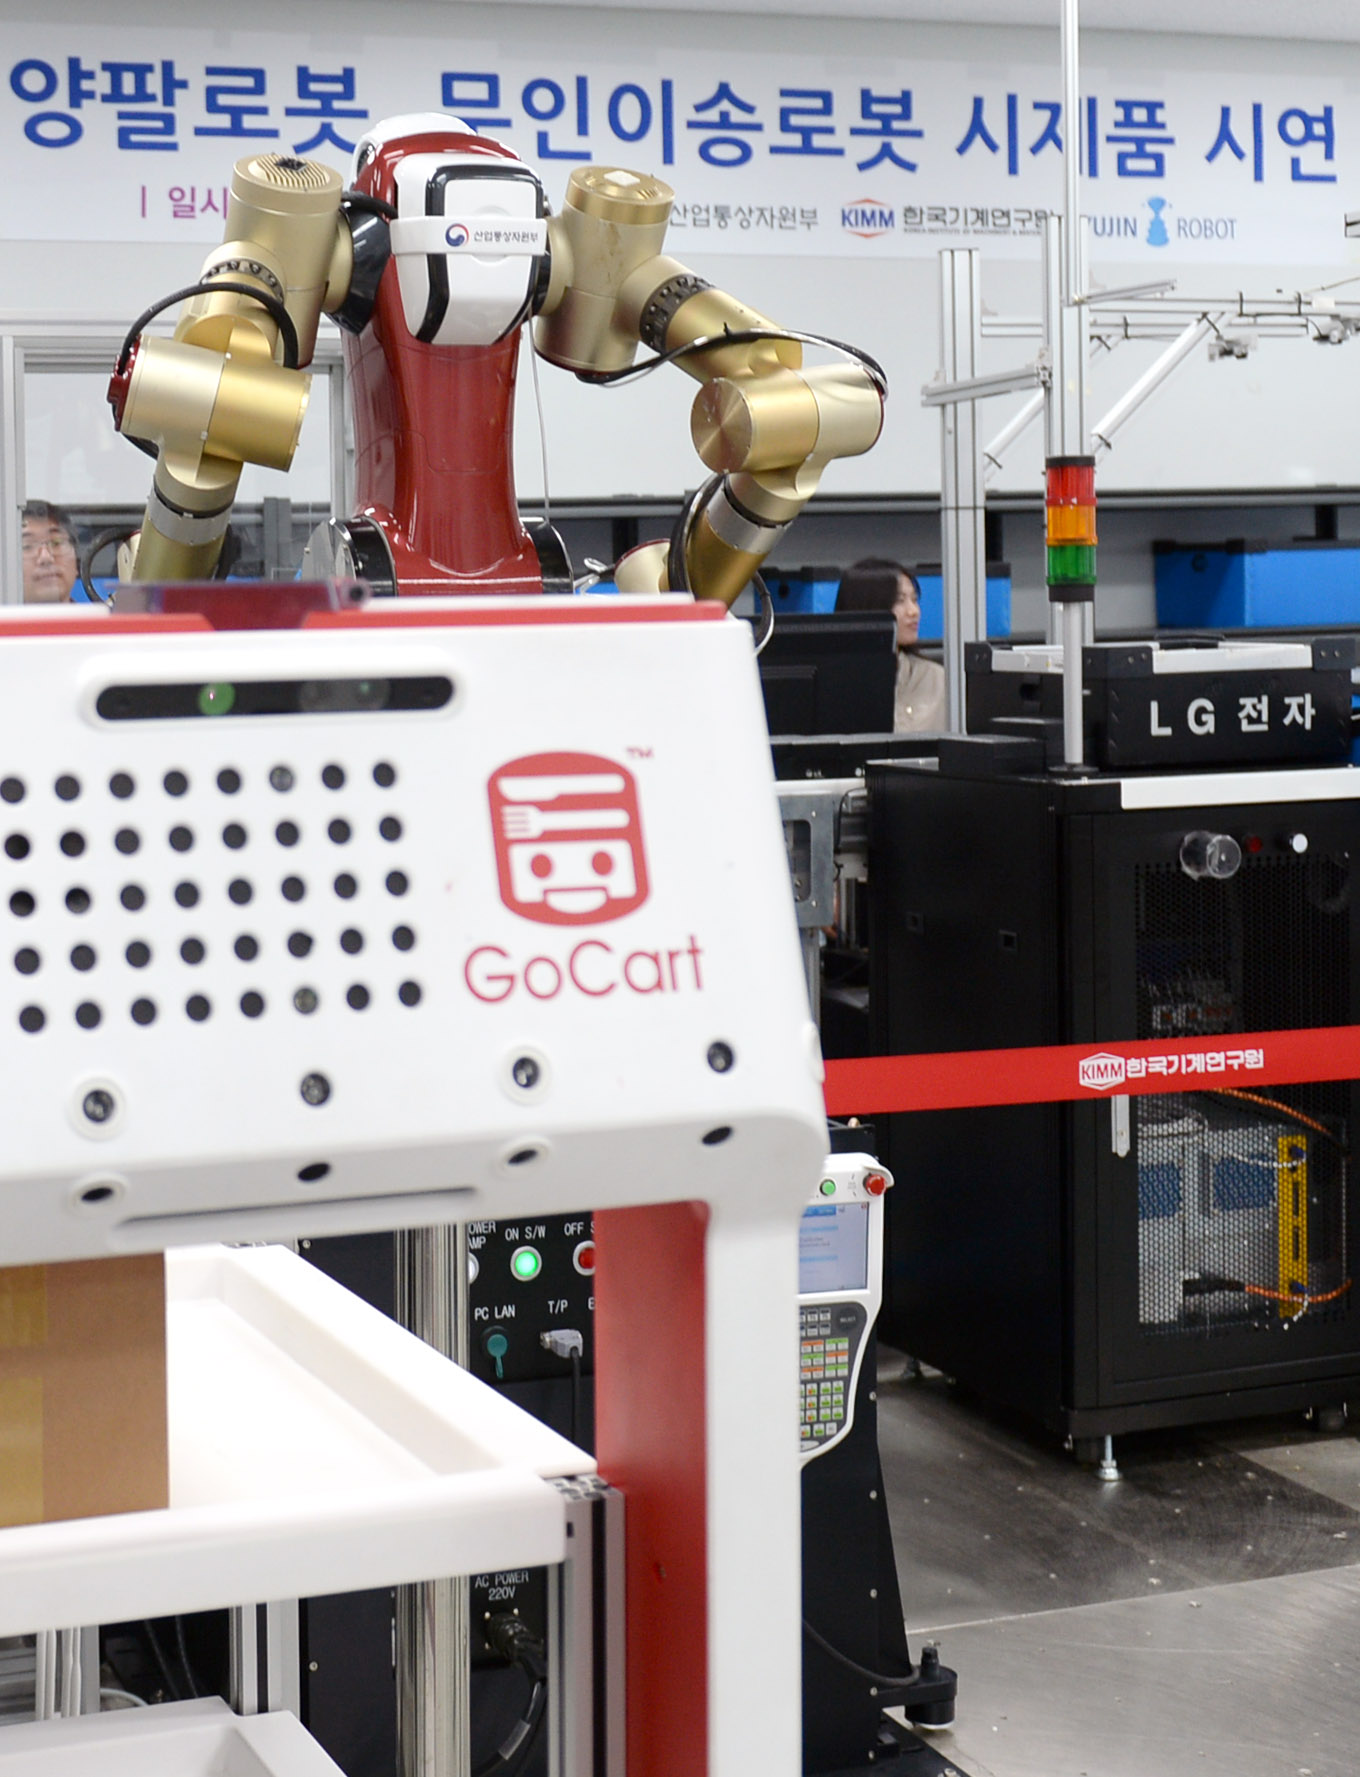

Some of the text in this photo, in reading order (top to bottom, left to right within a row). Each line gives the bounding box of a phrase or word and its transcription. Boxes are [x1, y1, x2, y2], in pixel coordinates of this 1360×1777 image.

[9, 56, 1338, 183] 양팔로봇 무인이송로봇 시제품 시연
[168, 185, 228, 219] 일시
[669, 203, 819, 231] 산업통상자원부
[841, 208, 895, 229] KIMM
[473, 230, 539, 244] 산업통상자원부
[1087, 215, 1238, 240] UJIN ROBOT
[1150, 693, 1316, 737] LG 전자
[464, 935, 703, 1003] GoCart
[1081, 1062, 1123, 1081] KIMM
[1126, 1048, 1264, 1079] 한국기계연구원
[468, 1220, 497, 1235] OWER
[504, 1225, 546, 1241] ON S/W
[563, 1221, 584, 1236] OFF
[474, 1304, 516, 1321] PC LAN
[547, 1299, 568, 1314] T/P
[474, 1569, 529, 1589] AC POWER
[488, 1585, 516, 1601] 220V
